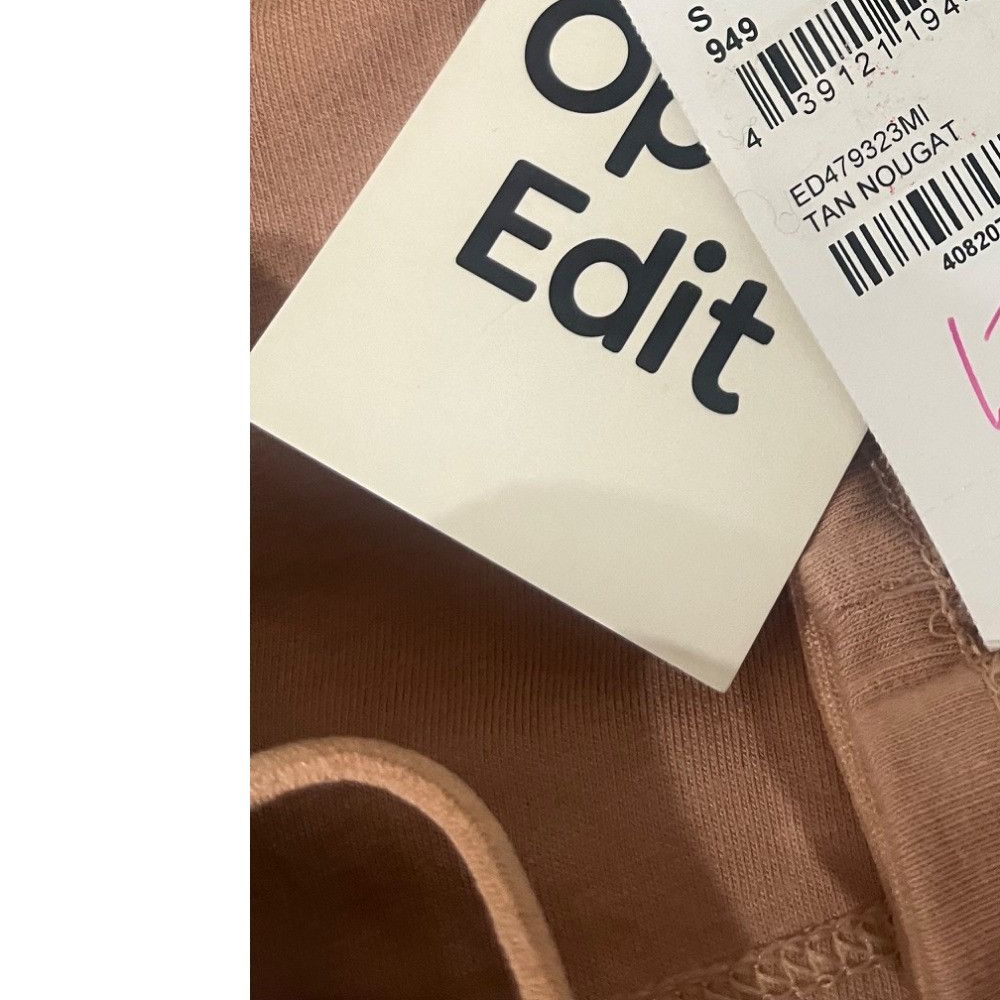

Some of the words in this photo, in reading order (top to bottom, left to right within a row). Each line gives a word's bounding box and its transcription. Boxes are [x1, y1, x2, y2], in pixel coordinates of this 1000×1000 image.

[687, 5, 713, 33] S
[706, 16, 759, 64] 949
[747, 127, 762, 148] 4
[797, 38, 893, 115] 39121
[789, 104, 931, 208] ED479323MI
[803, 190, 857, 233] TAN
[857, 119, 961, 200] NOUGAT
[455, 158, 776, 415] Edit
